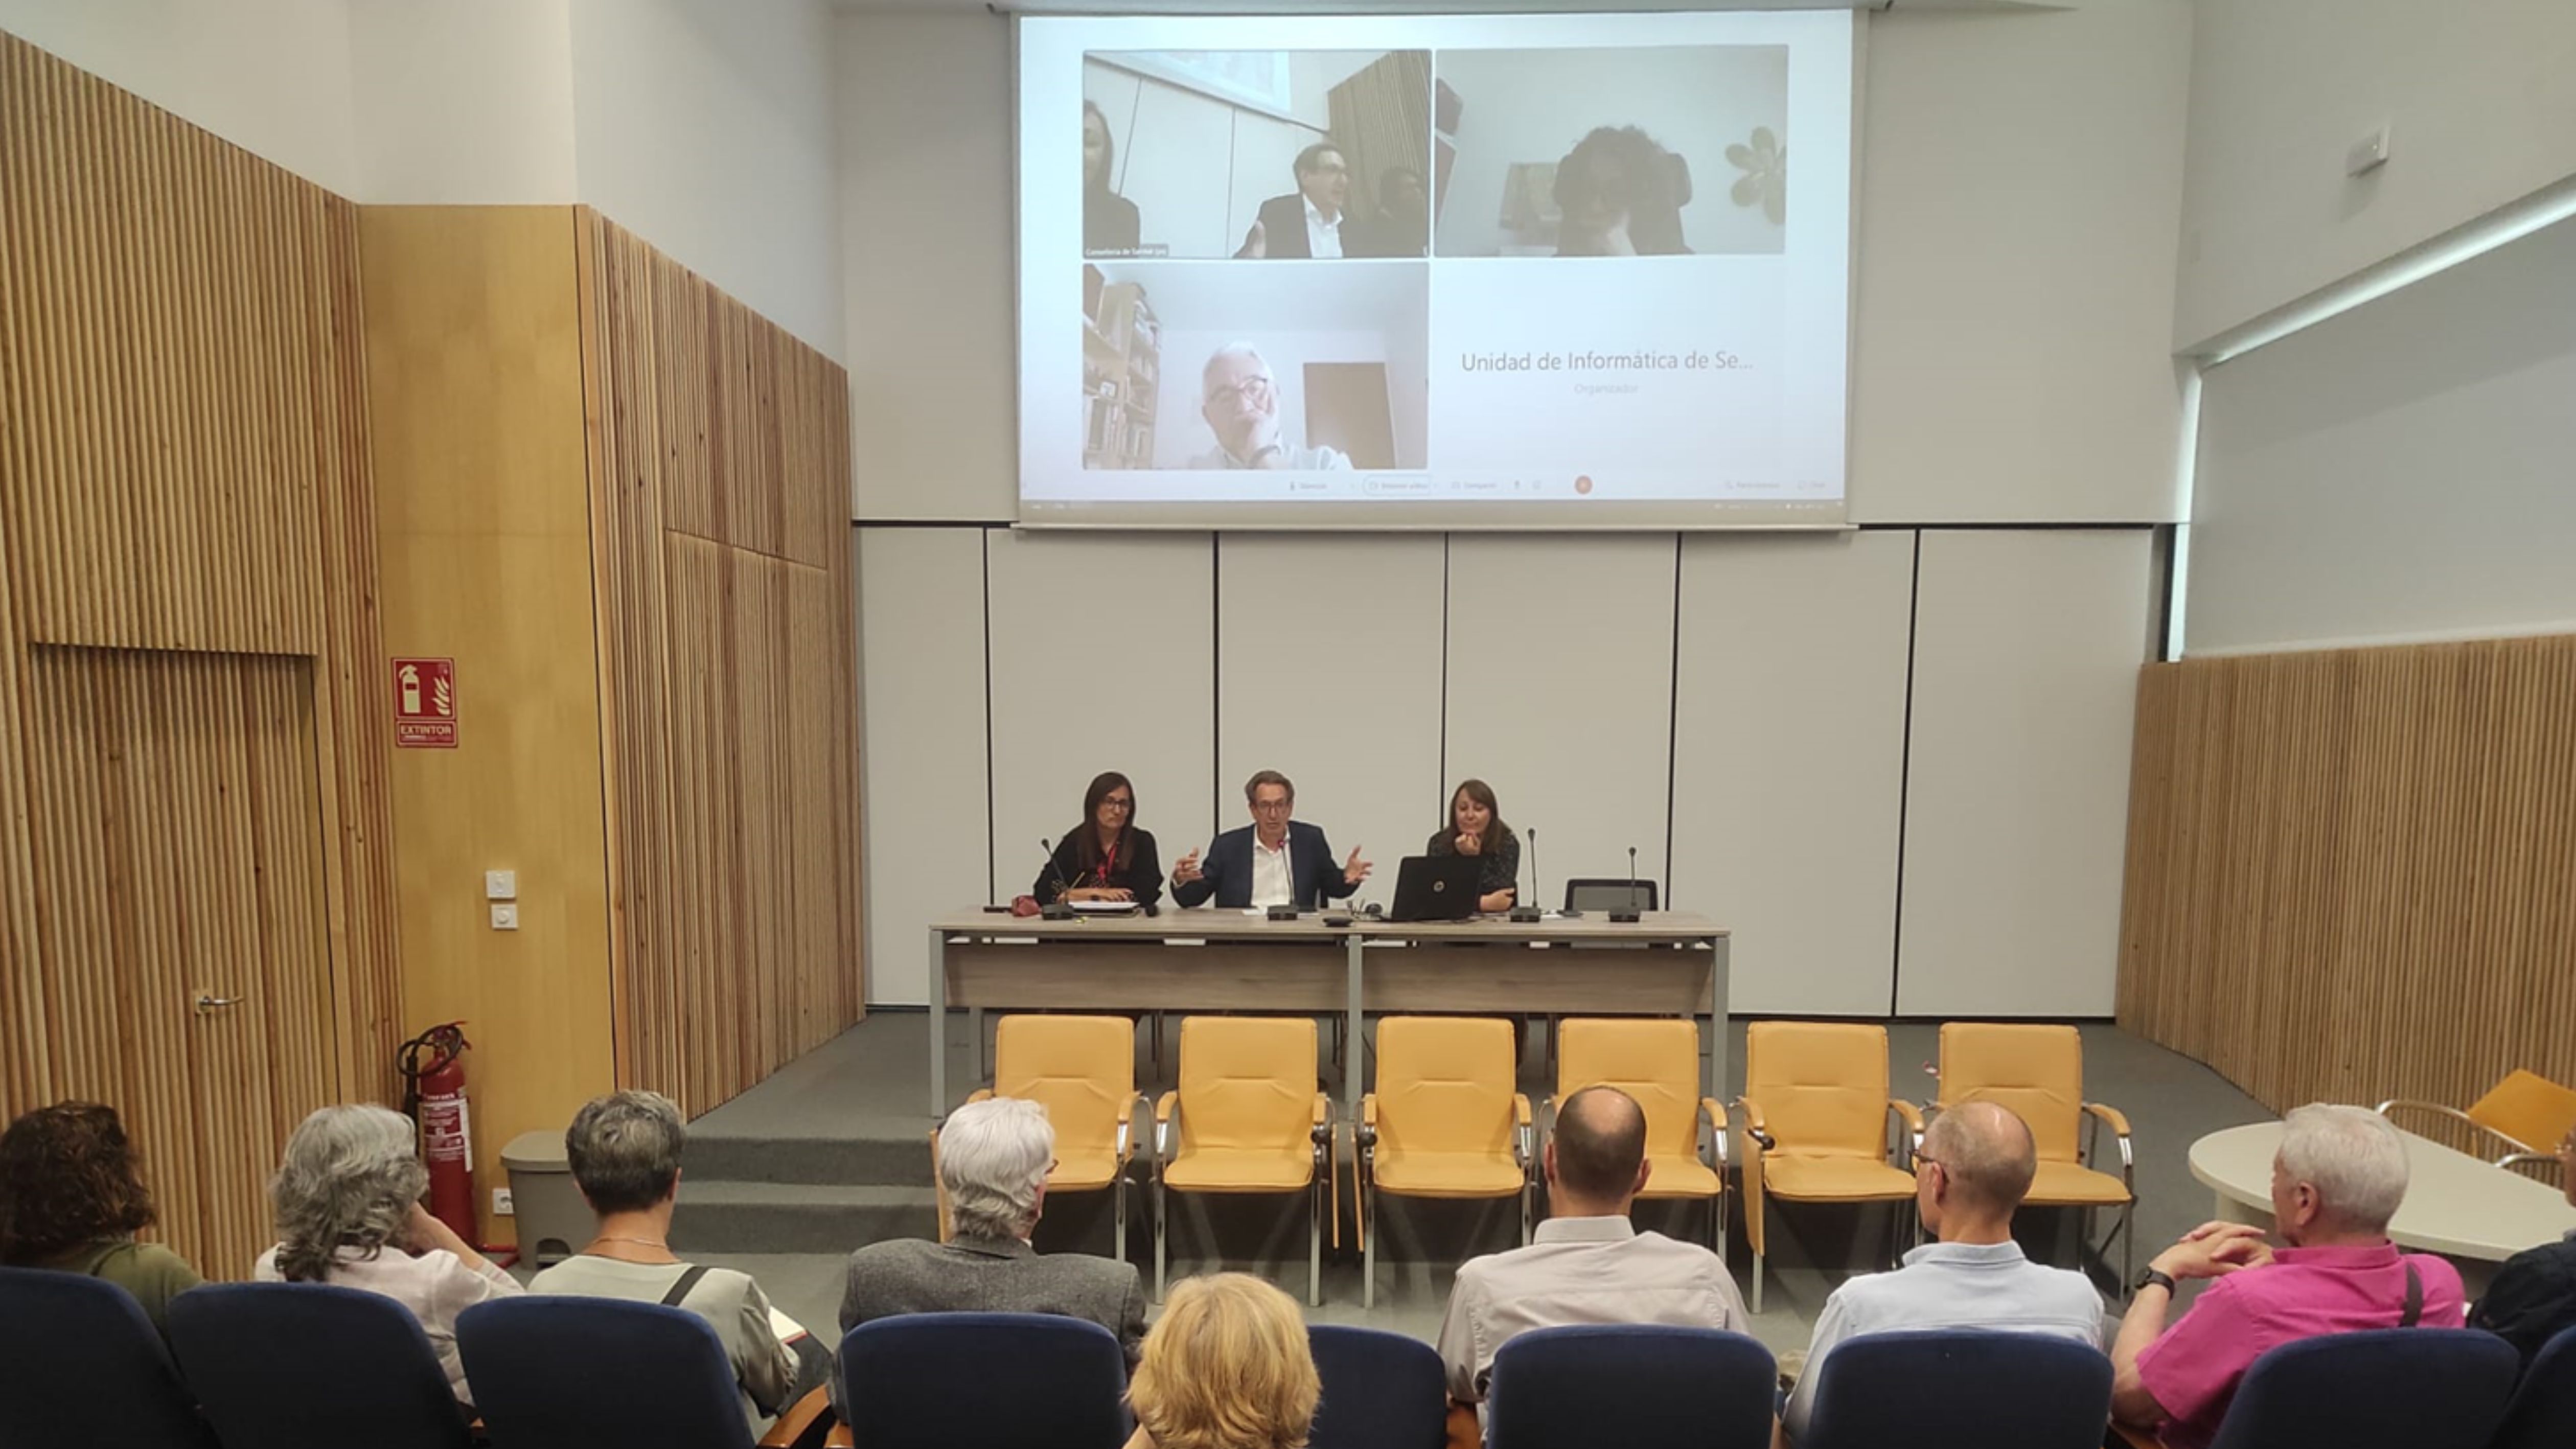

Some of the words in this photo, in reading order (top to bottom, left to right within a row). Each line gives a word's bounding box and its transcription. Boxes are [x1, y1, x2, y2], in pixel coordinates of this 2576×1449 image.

[1462, 352, 1531, 371] Unidad
[1536, 351, 1561, 371] de
[1568, 350, 1678, 370] Informática
[1684, 350, 1709, 369] de
[1715, 351, 1754, 369] Se...
[1574, 383, 1638, 395] Organizador
[401, 725, 451, 734] EXTINTOR
